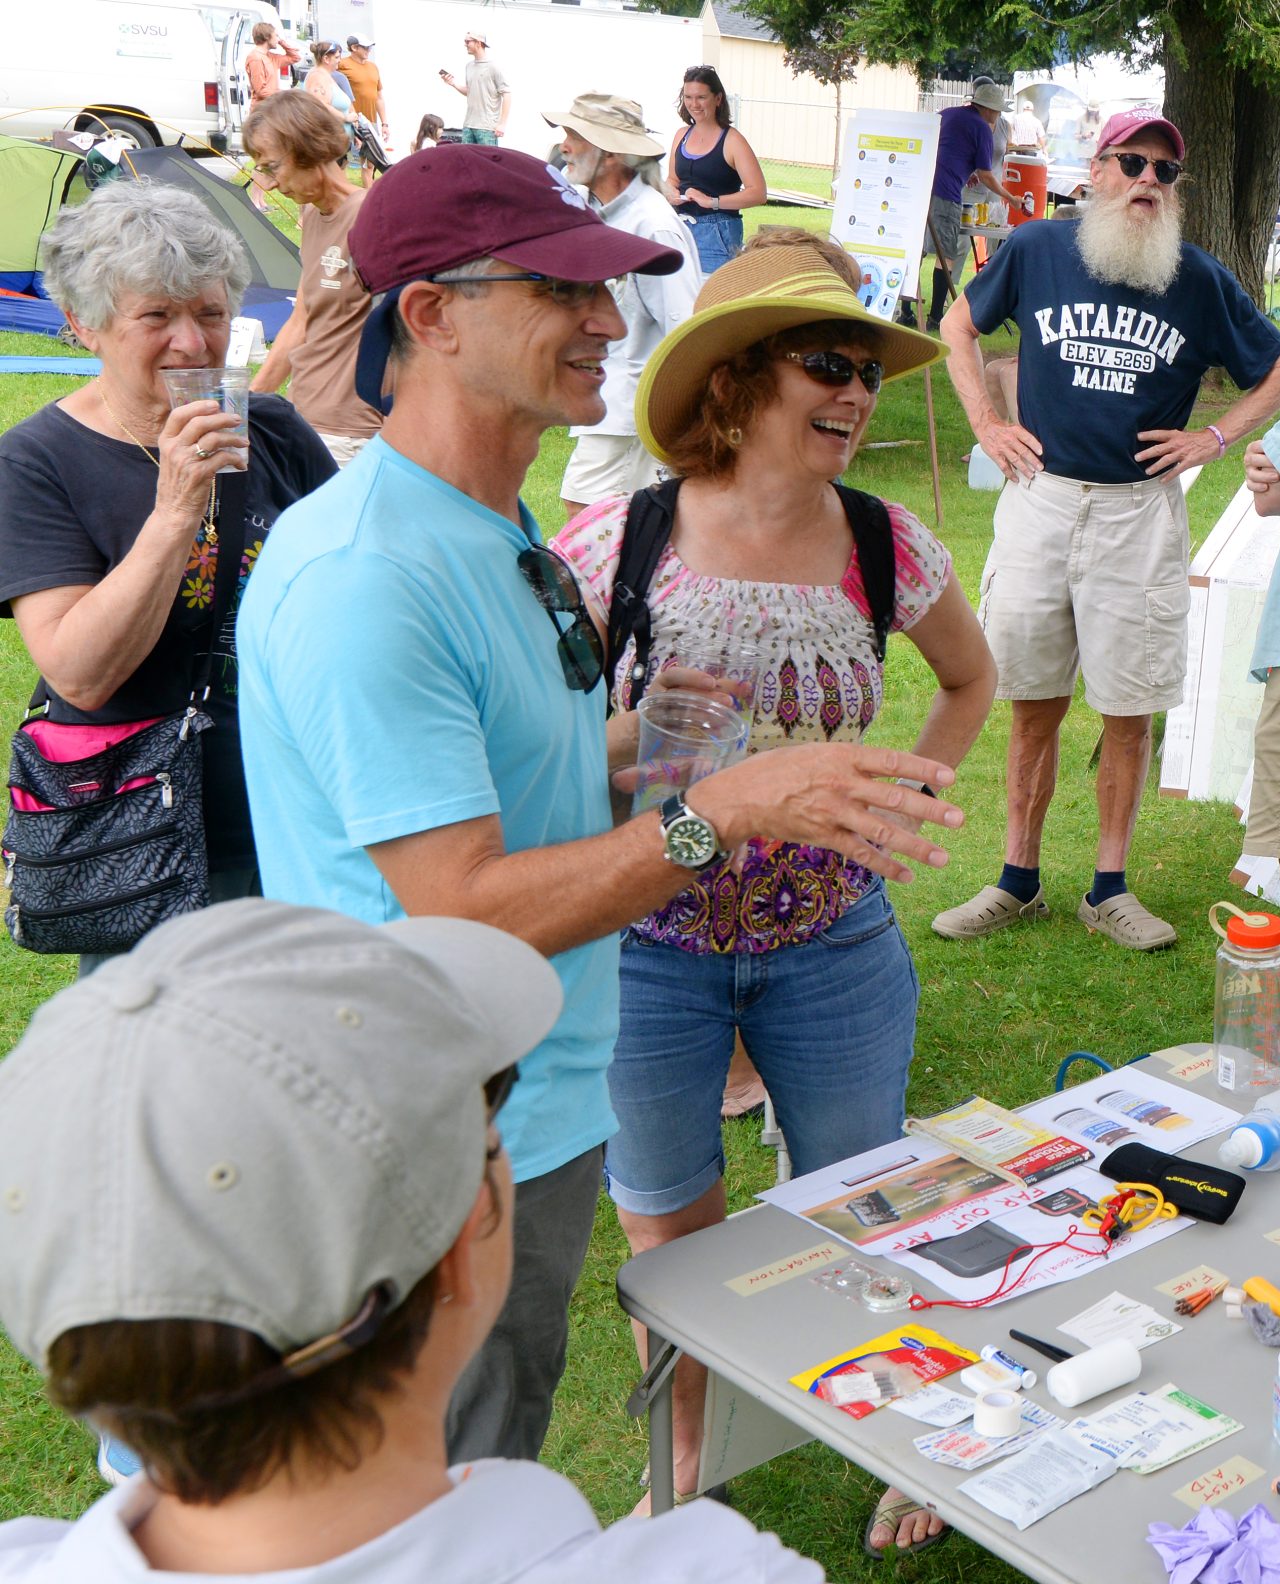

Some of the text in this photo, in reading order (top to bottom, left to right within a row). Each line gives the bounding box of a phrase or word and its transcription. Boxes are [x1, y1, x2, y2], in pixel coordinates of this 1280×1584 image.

[131, 24, 168, 36] SVSU
[1034, 303, 1186, 366] KATAHDIN
[1065, 343, 1151, 370] ELEV. 5269
[1072, 365, 1137, 394] MAINE
[1175, 1057, 1211, 1077] WATER
[1004, 1143, 1066, 1171] Mountains
[1047, 1145, 1081, 1161] White
[995, 1187, 1045, 1207] FAR
[951, 1207, 989, 1230] OUT
[893, 1231, 932, 1249] APP
[1191, 1468, 1223, 1492] AID
[1203, 1473, 1246, 1501] FIRST
